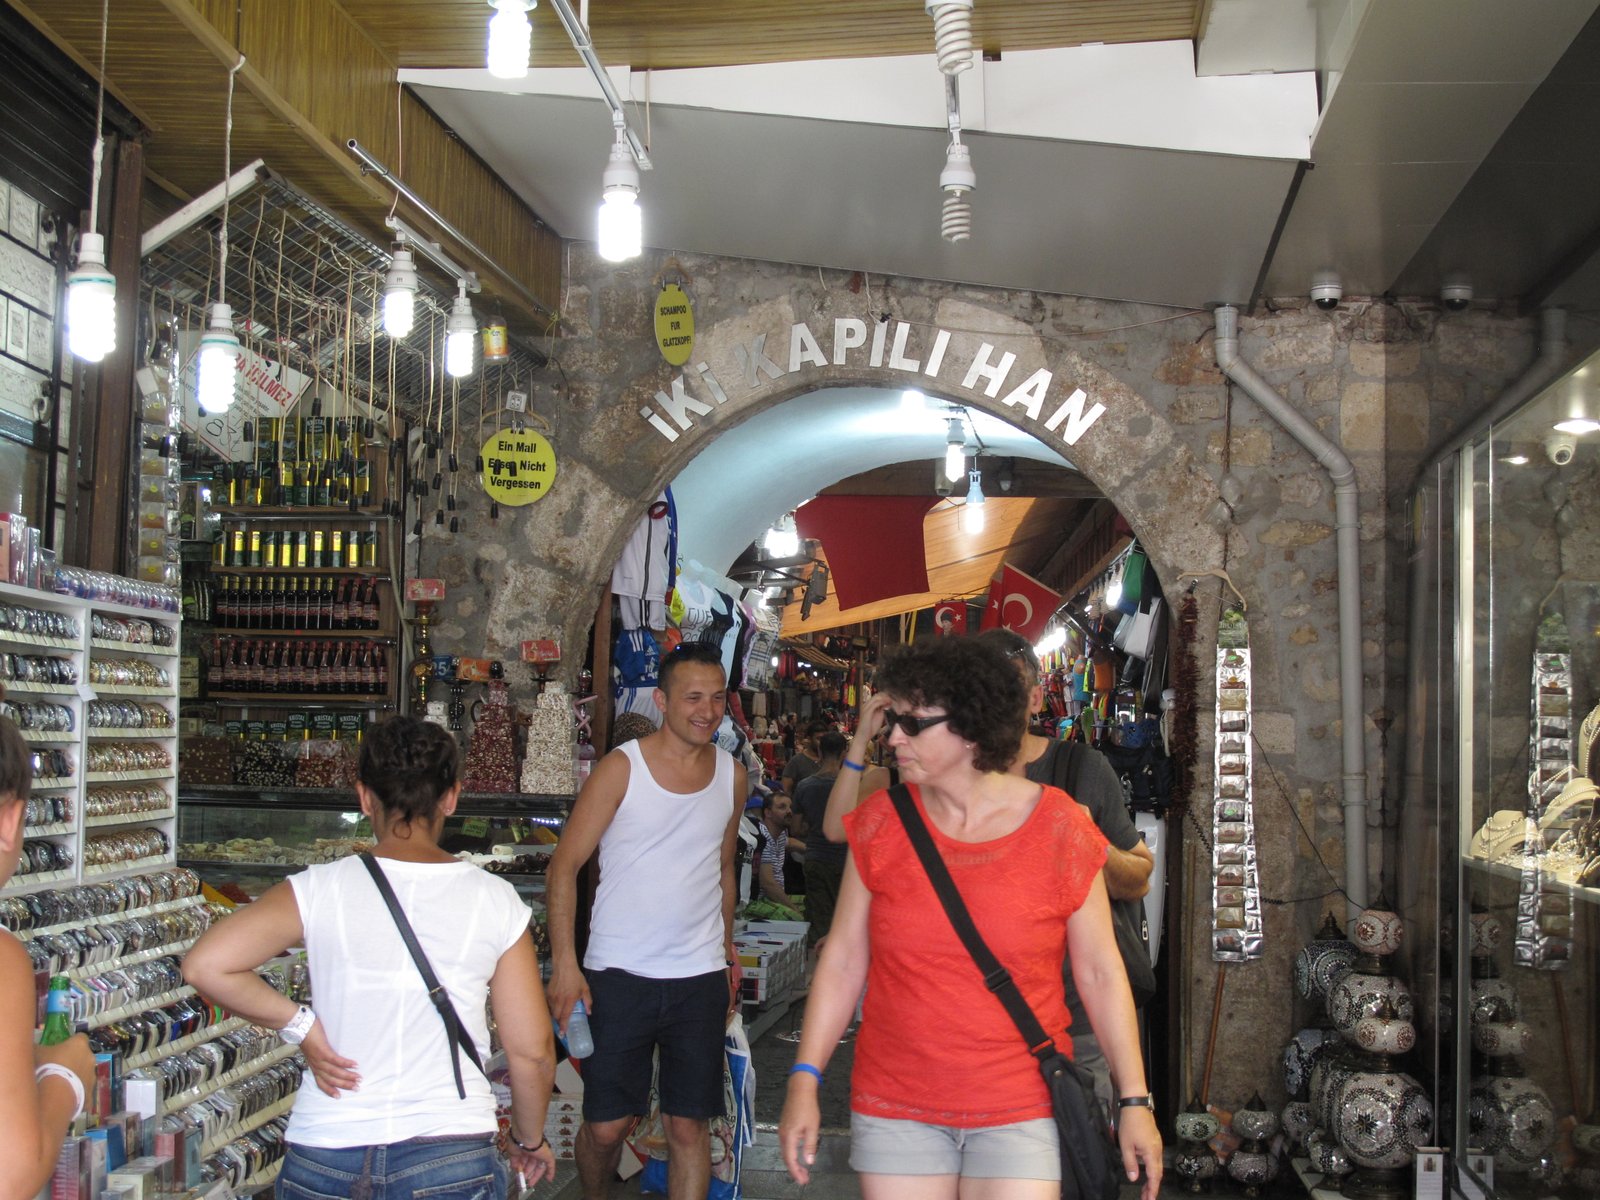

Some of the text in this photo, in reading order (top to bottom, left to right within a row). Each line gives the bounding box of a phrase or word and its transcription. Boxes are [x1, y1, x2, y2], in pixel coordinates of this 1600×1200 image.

[660, 305, 687, 316] SCHAMPOO
[662, 335, 692, 347] GLATZKOPF!
[733, 317, 952, 389] KAPILI
[961, 341, 1107, 446] HAN
[498, 441, 537, 453] Ein Mall
[520, 461, 546, 472] Nicht
[490, 476, 541, 489] Vergessen
[313, 714, 334, 722] KRISTAL
